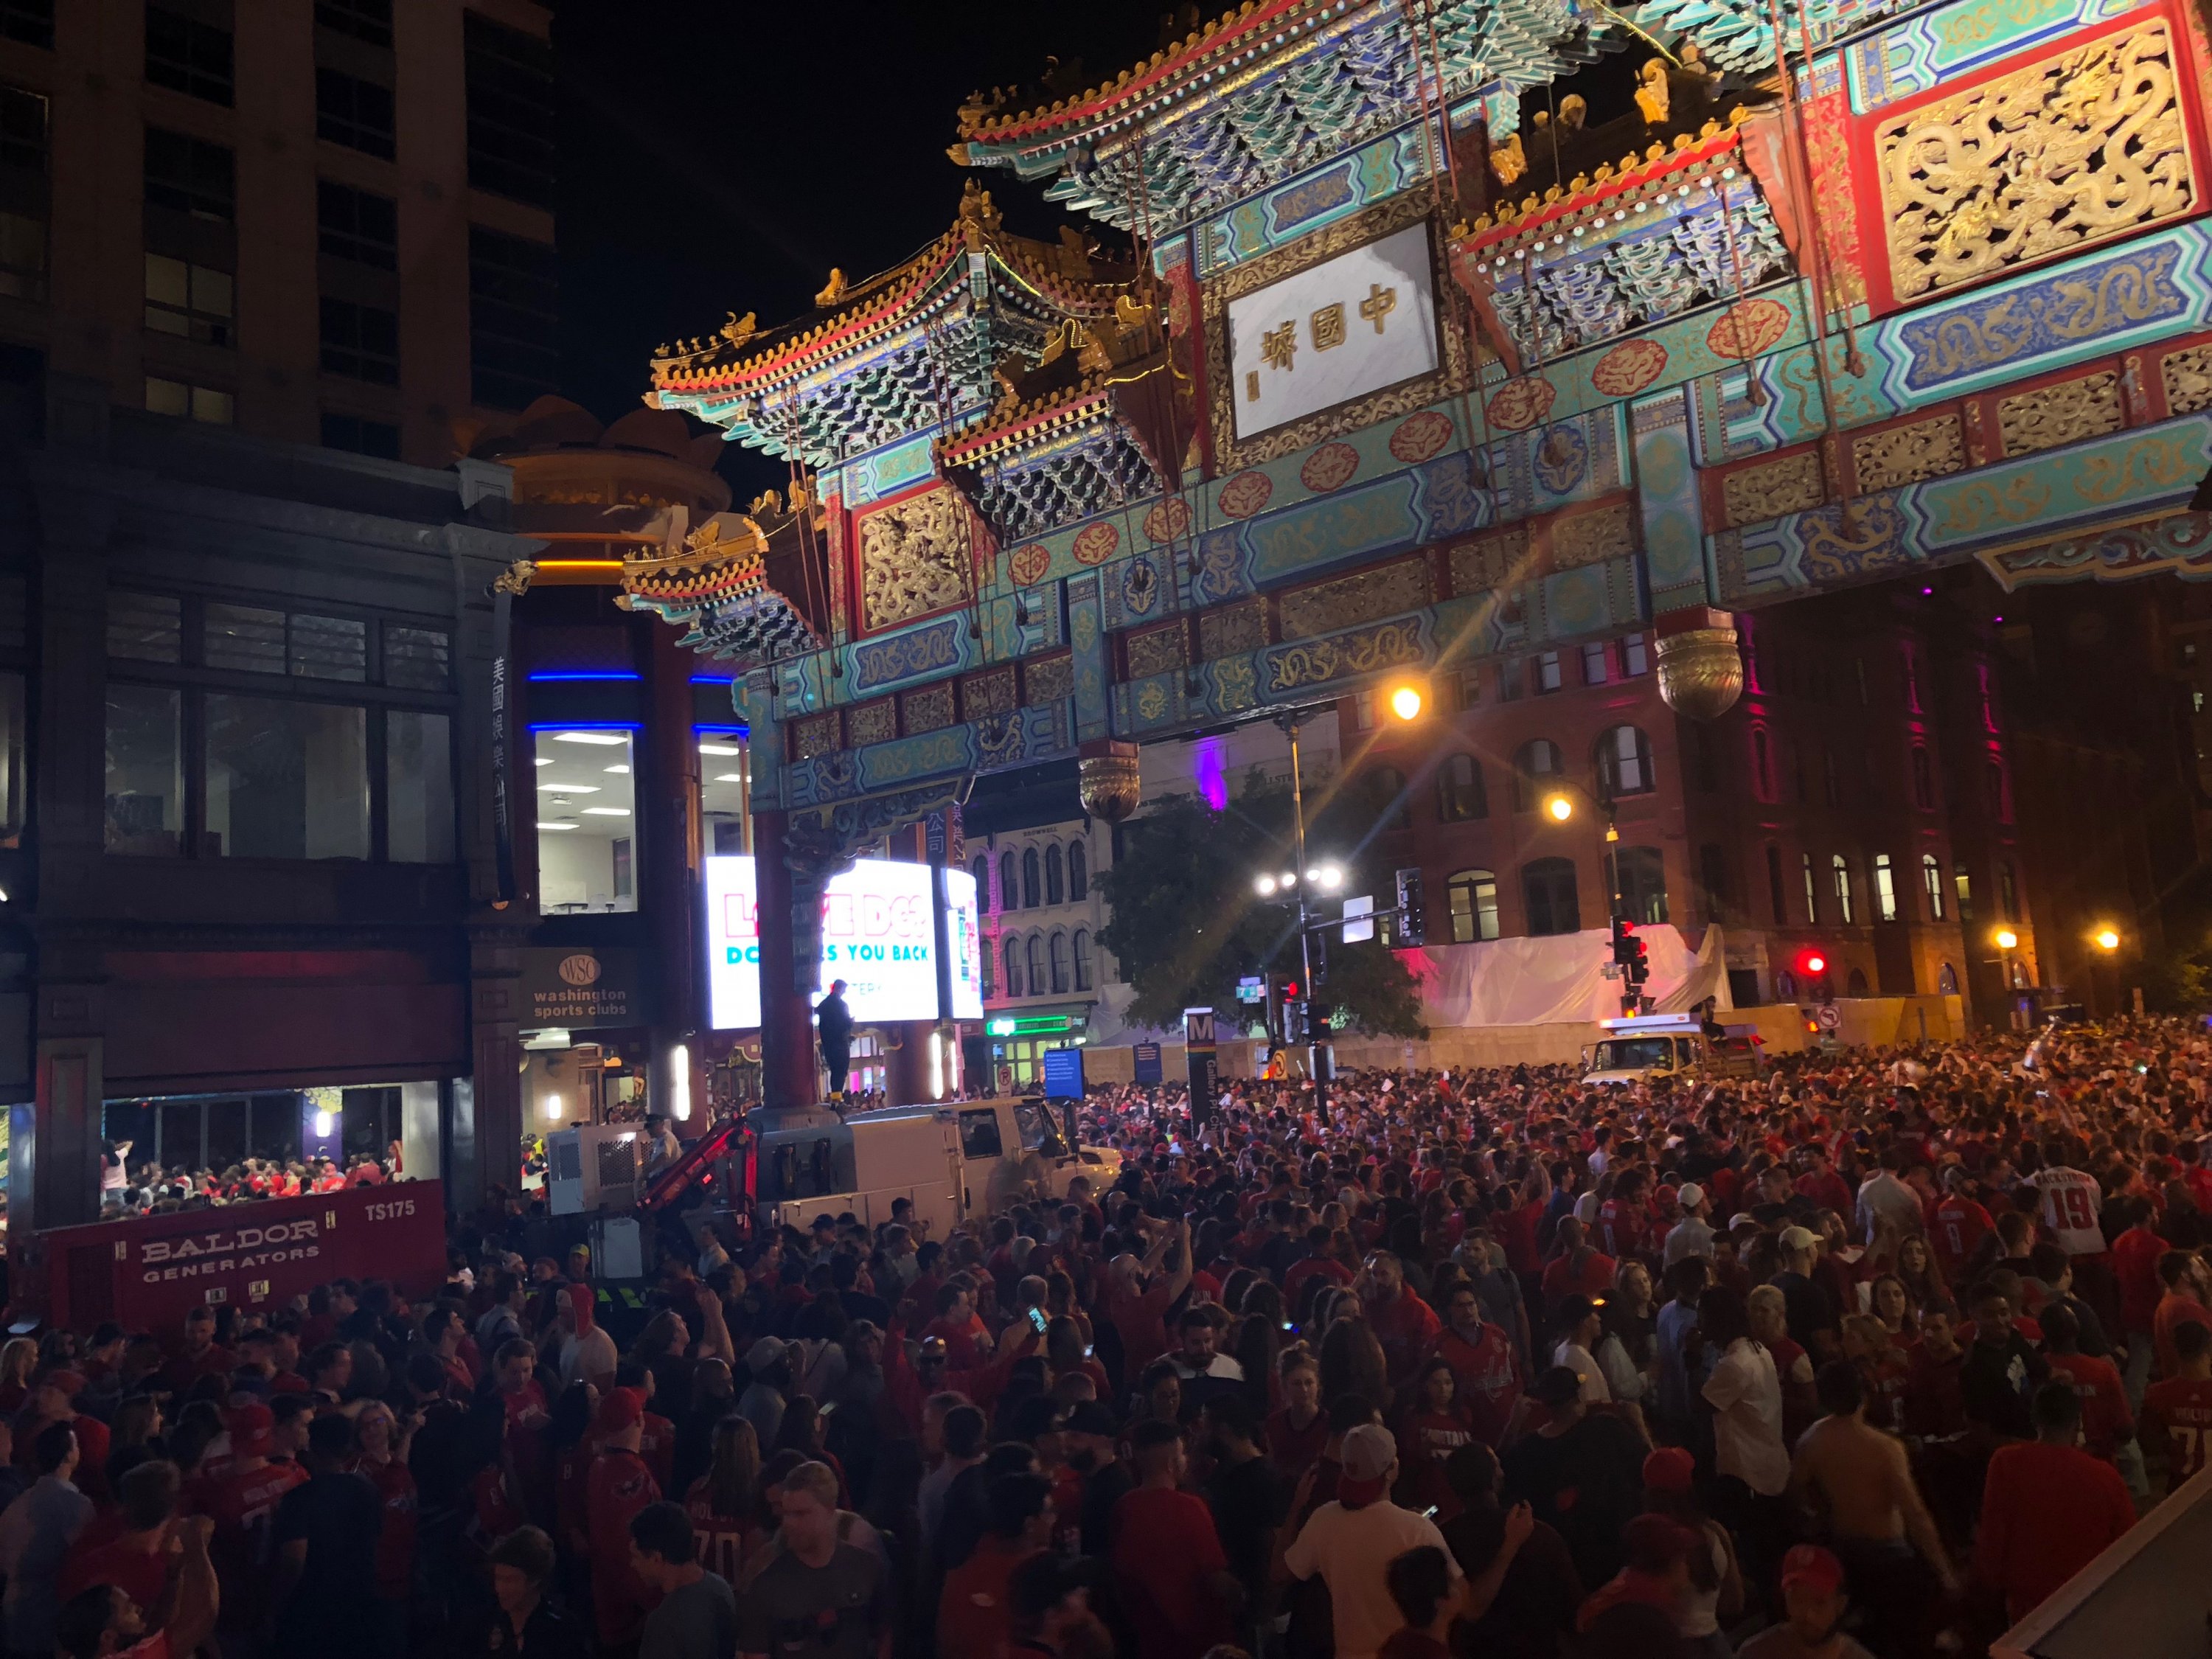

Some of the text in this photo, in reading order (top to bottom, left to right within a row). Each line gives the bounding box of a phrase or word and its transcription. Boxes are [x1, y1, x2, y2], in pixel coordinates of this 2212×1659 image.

[848, 945, 884, 961] YOU
[892, 945, 928, 961] BACK
[534, 988, 626, 1003] washington
[534, 1003, 627, 1020] sports clubs
[1189, 1015, 1214, 1040] M
[1206, 1060, 1217, 1096] Gallery
[365, 1200, 415, 1222] TS175
[2051, 1187, 2093, 1229] 19
[142, 1220, 319, 1263] BALDOR
[143, 1245, 320, 1283] GENERATORS
